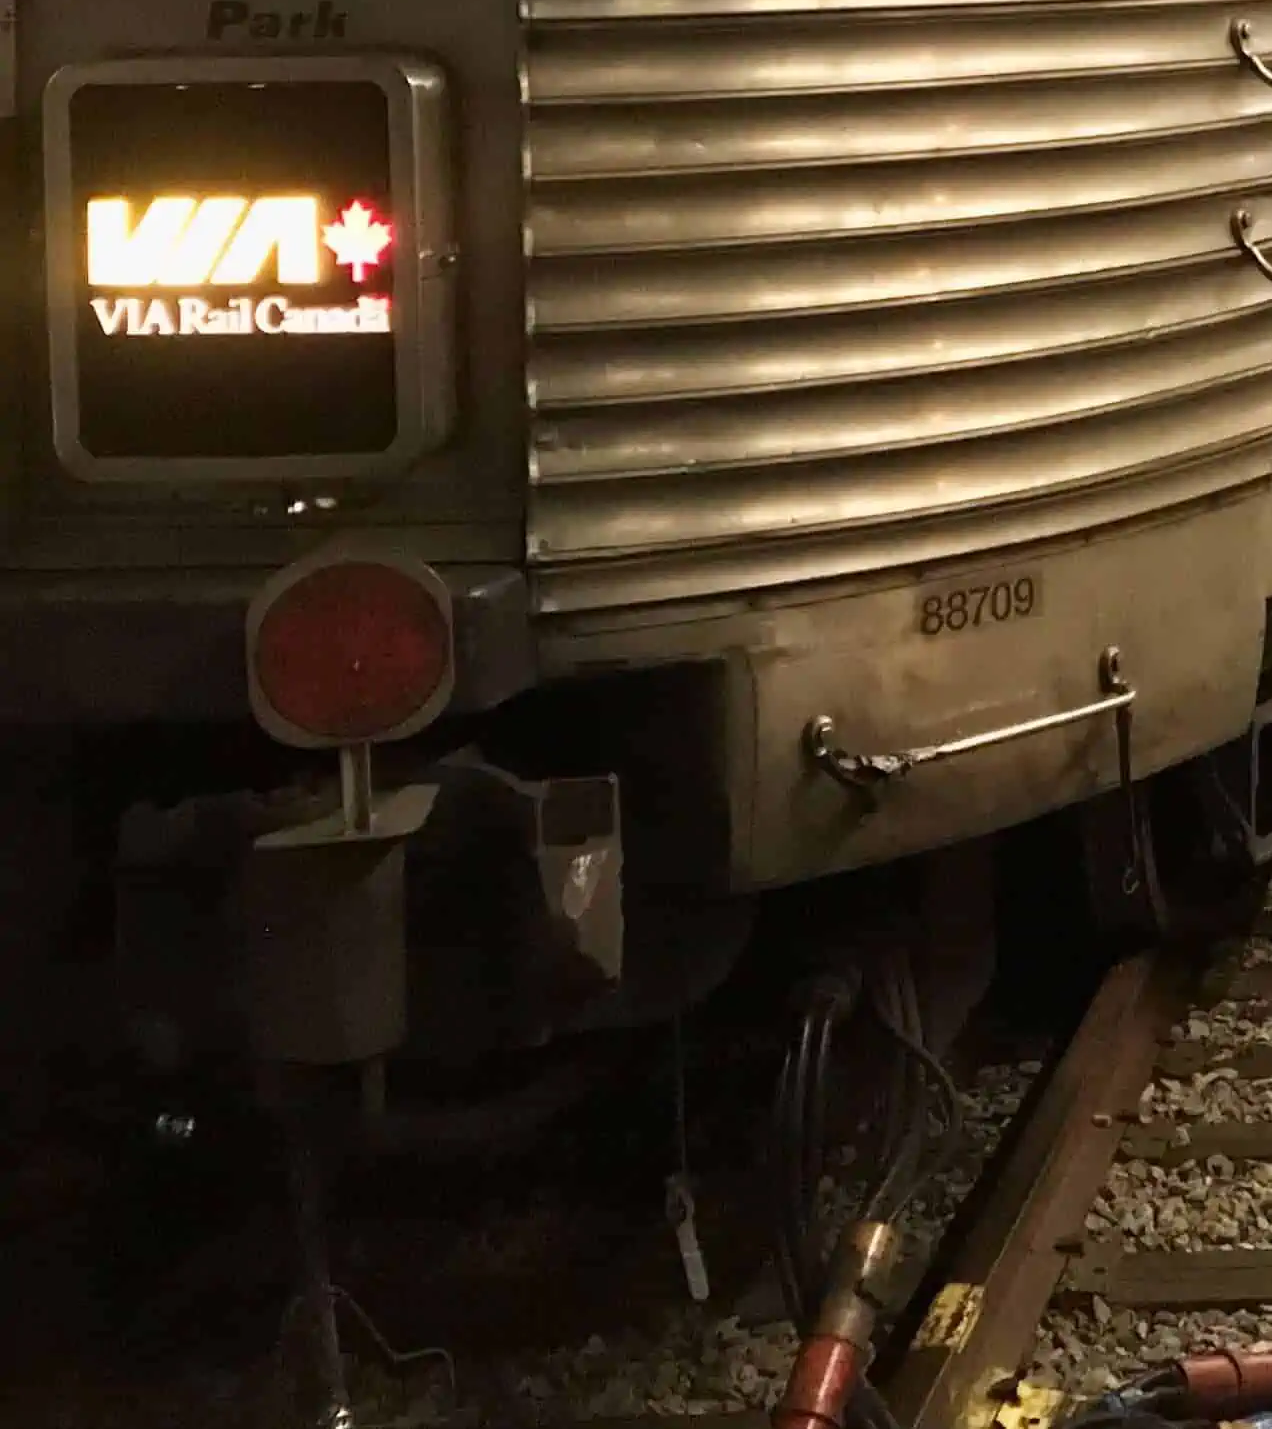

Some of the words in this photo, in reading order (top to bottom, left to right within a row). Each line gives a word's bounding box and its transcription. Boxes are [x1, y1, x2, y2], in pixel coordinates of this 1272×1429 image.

[207, 1, 348, 41] Park
[86, 196, 320, 287] VIA
[91, 299, 179, 335] VIA
[180, 299, 252, 335] Rail
[256, 299, 390, 335] Canada
[920, 577, 1035, 636] 88709
